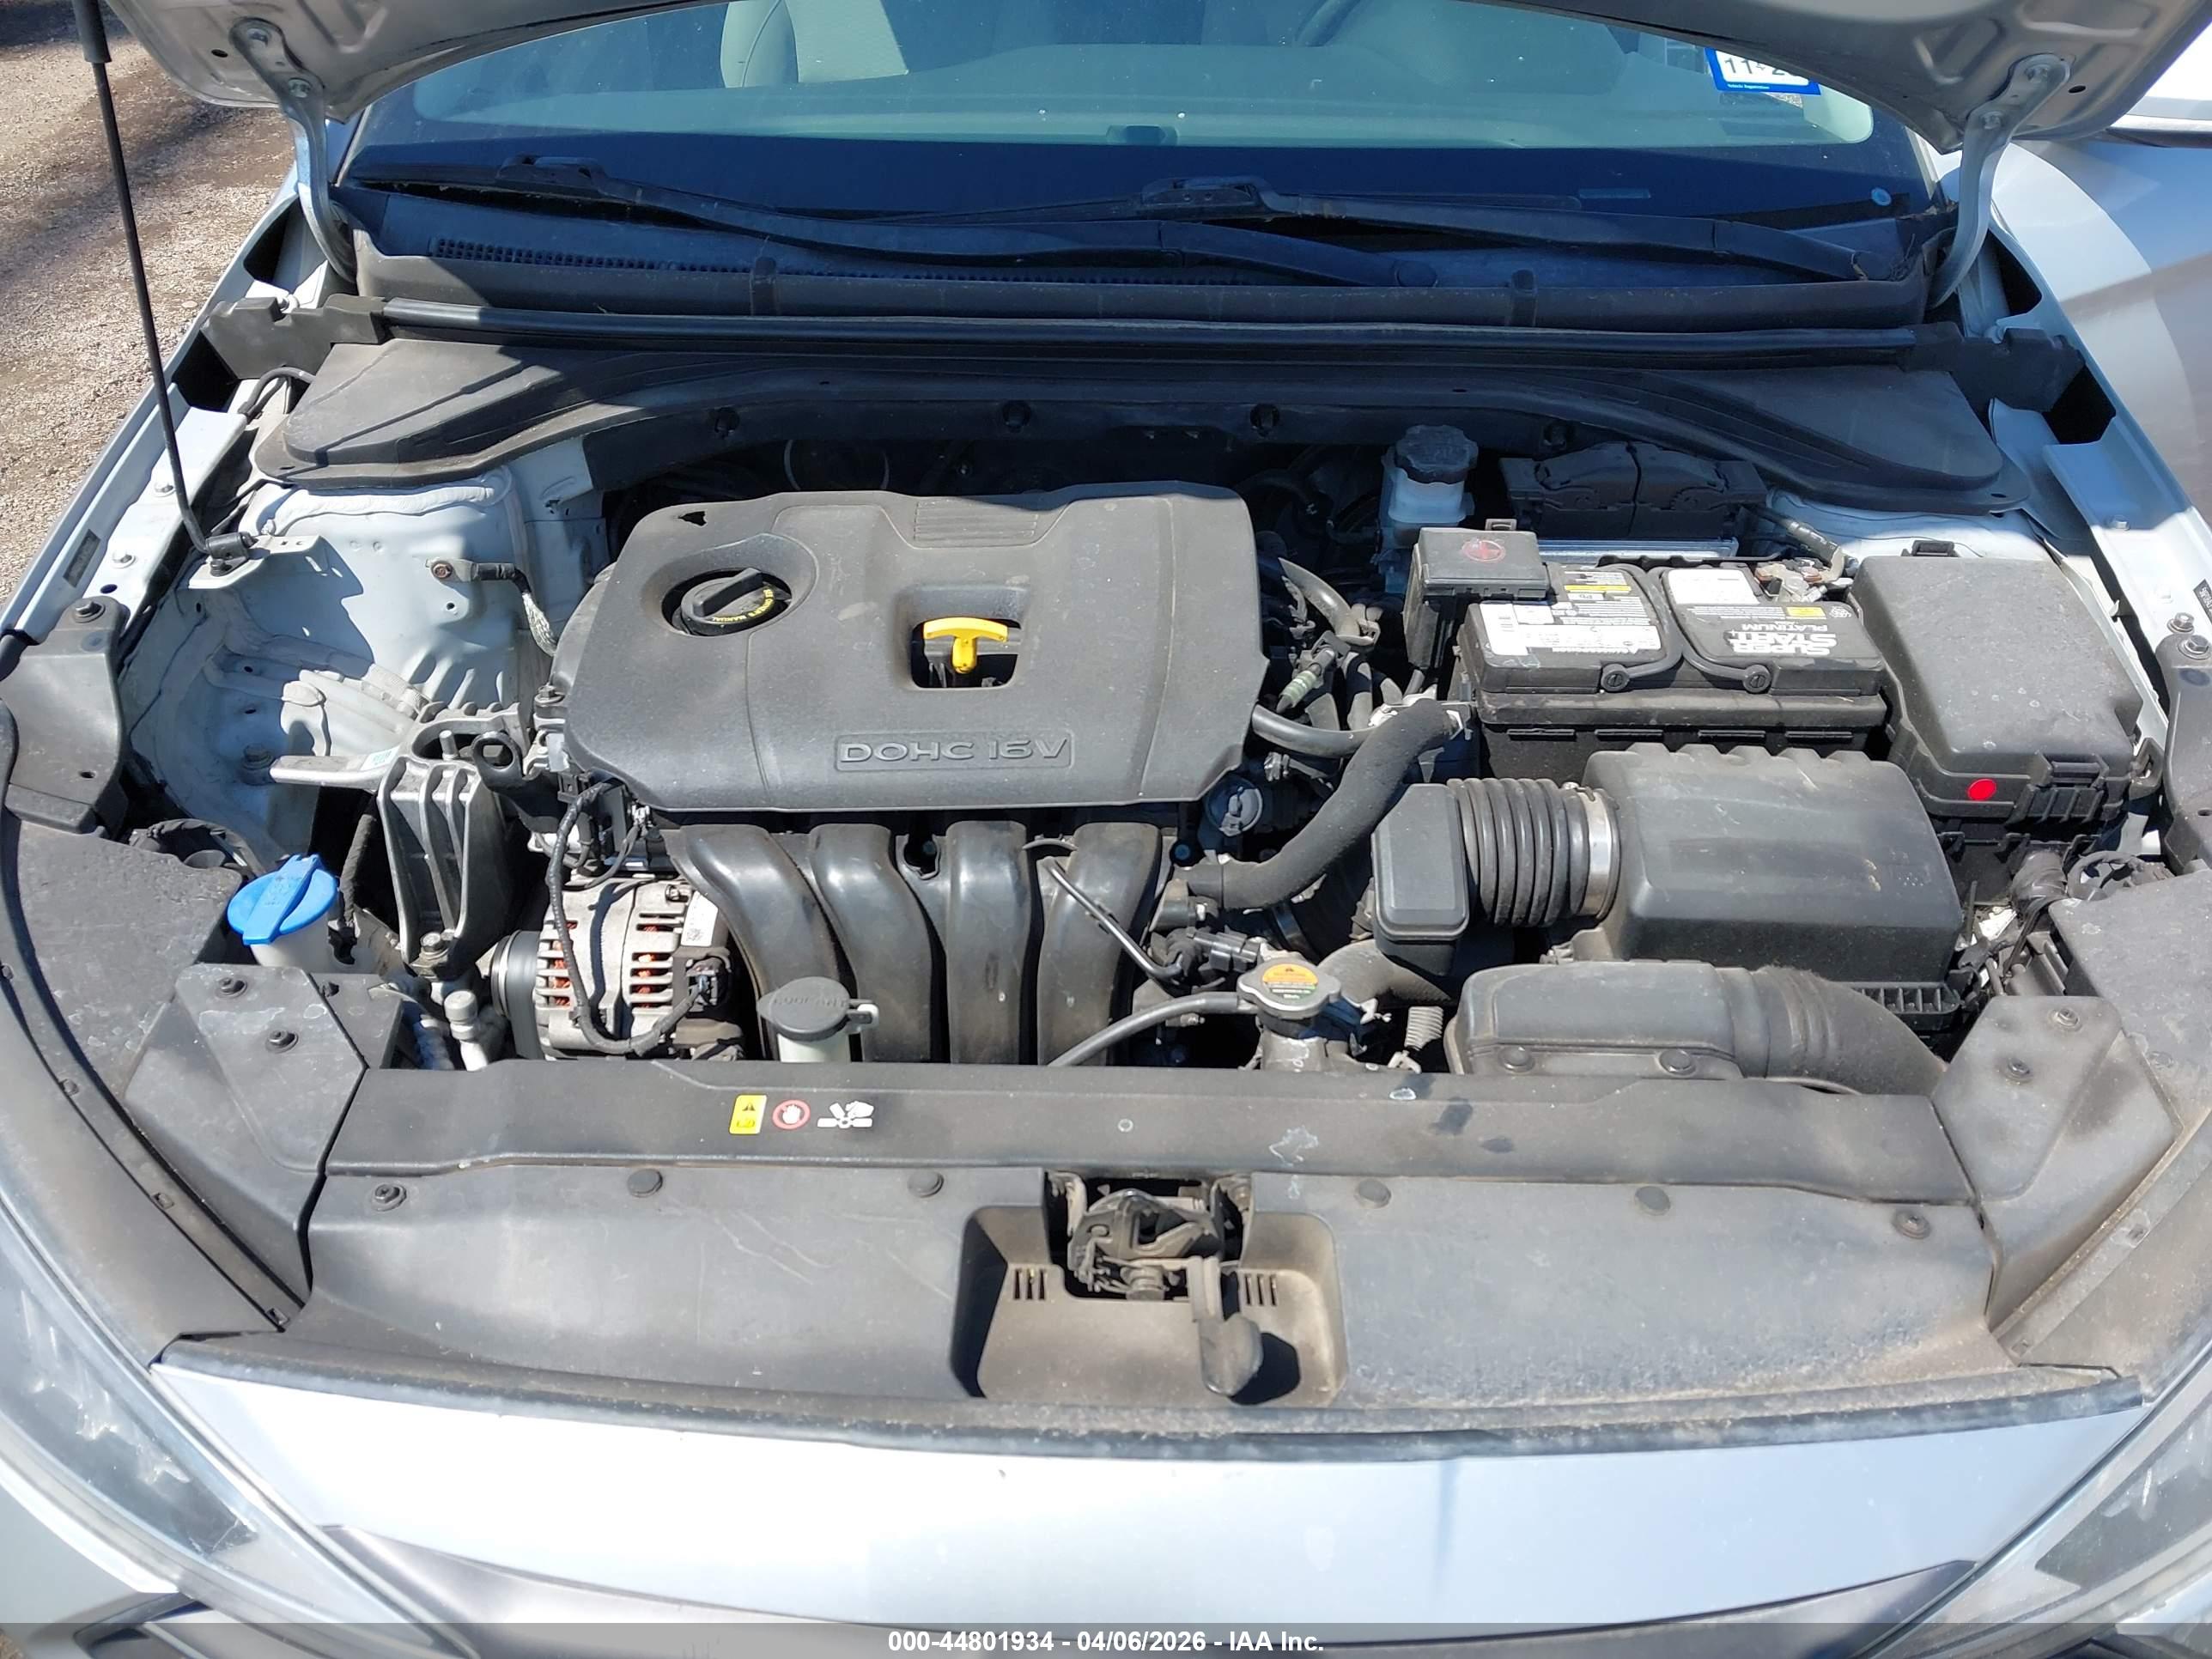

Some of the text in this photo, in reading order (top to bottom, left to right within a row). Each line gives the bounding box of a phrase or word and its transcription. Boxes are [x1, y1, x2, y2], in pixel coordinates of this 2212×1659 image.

[1723, 57, 1753, 75] 11
[1741, 623, 1828, 632] PLATINUM
[1728, 631, 1838, 647] START
[1733, 642, 1830, 655] SUPER
[839, 738, 1068, 763] DOHC 16V
